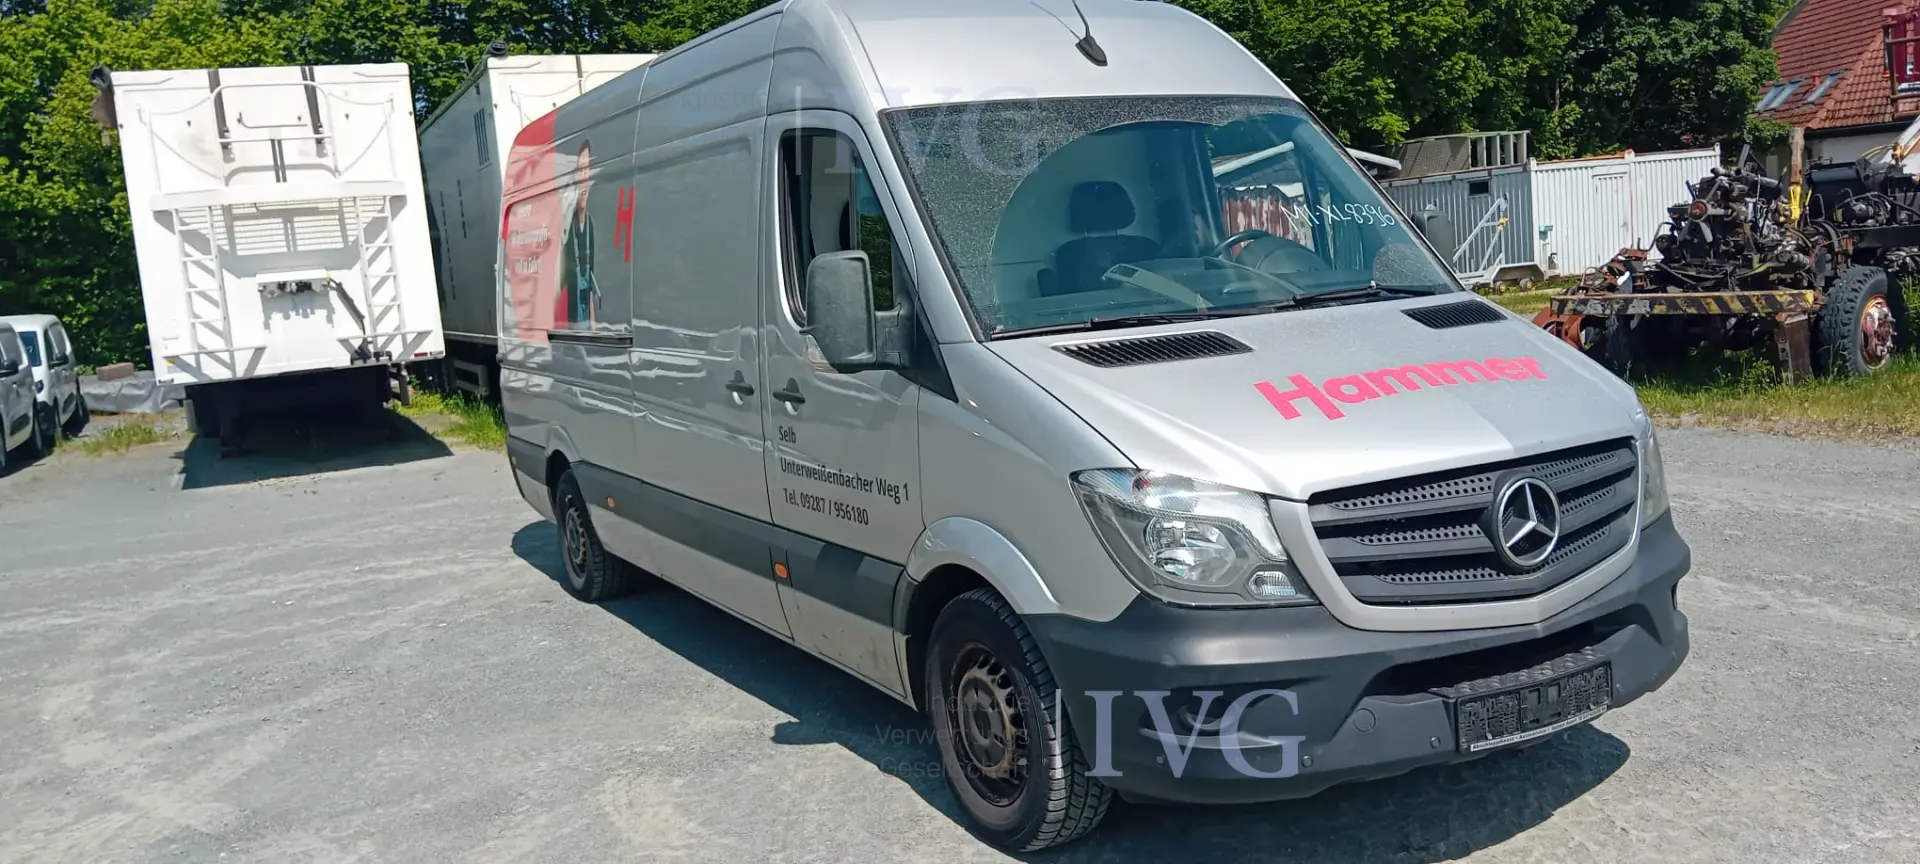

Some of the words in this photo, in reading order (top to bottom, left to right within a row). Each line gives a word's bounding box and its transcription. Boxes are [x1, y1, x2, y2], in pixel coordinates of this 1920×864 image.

[615, 184, 635, 263] H
[1253, 356, 1549, 421] Hammer
[778, 425, 797, 444] Selb
[780, 456, 874, 493] Unterweißenbacher
[875, 476, 901, 505] Weg
[903, 482, 909, 501] 1
[783, 487, 799, 507] Tel.
[800, 492, 825, 514] 09287
[834, 500, 869, 526] 956180
